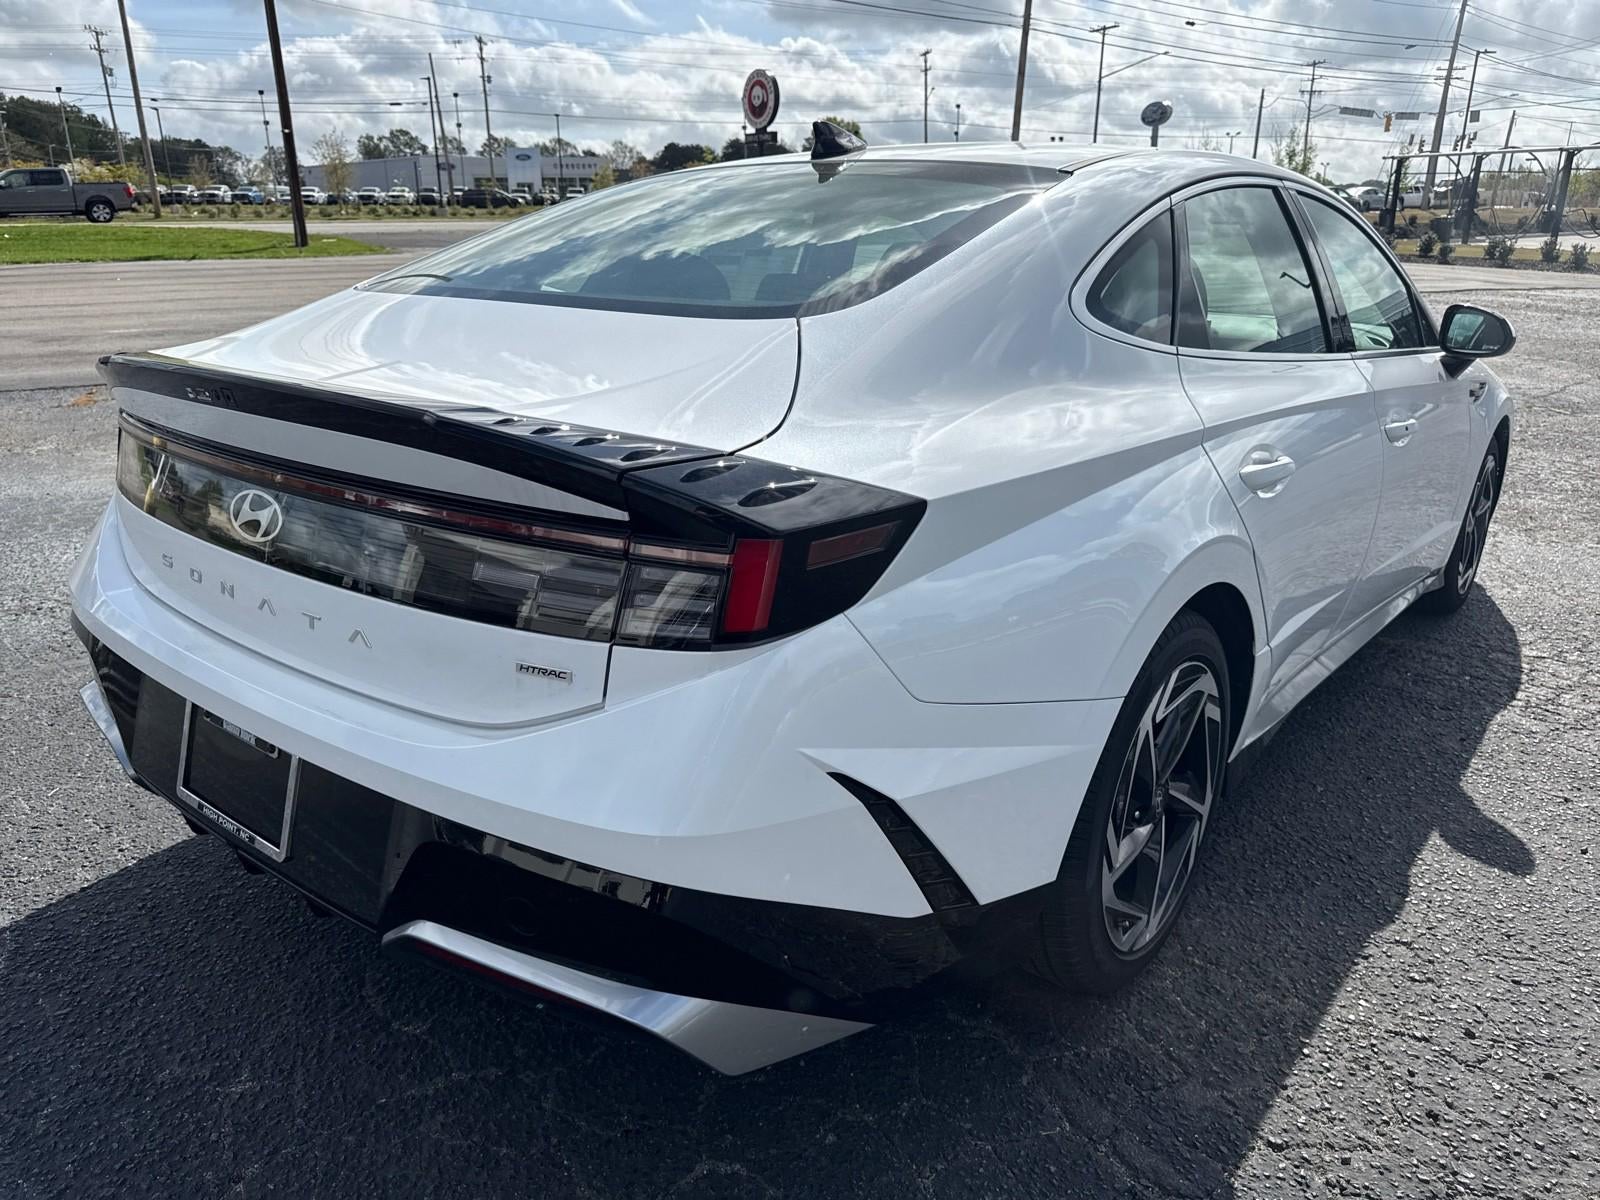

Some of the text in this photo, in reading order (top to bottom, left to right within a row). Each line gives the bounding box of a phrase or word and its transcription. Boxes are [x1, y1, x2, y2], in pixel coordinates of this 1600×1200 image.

[162, 553, 373, 649] SONATA
[519, 663, 568, 680] HTRAC
[203, 806, 218, 820] HIGH
[240, 829, 250, 841] NC
